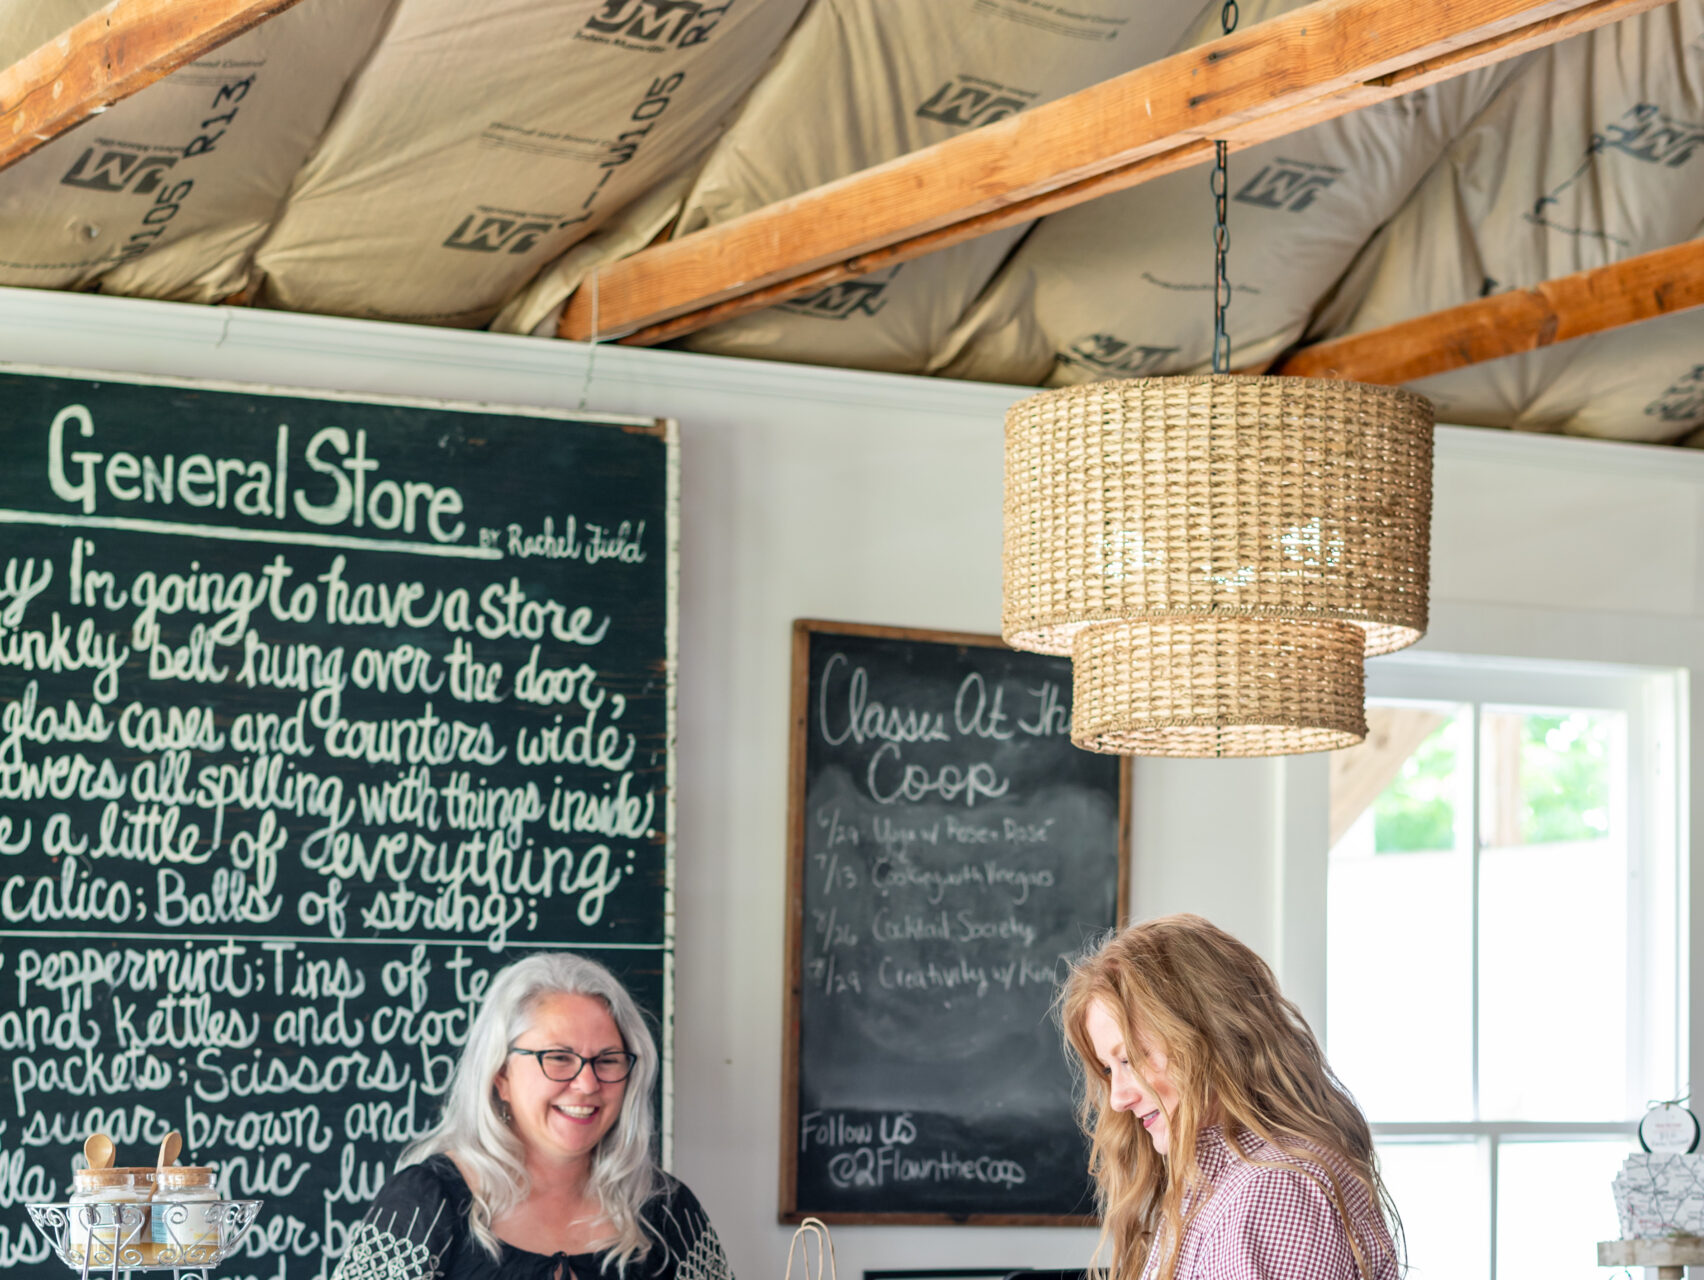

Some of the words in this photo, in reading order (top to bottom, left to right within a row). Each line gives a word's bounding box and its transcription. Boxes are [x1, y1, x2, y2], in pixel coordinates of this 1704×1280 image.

[182, 72, 257, 160] R13
[294, 427, 466, 543] Store
[506, 514, 582, 560] Rachel
[585, 519, 647, 565] Field
[70, 537, 128, 610] I'm
[132, 561, 271, 652] going
[262, 554, 318, 624] to
[318, 555, 444, 629] have
[443, 587, 474, 632] a
[475, 576, 611, 646] store
[149, 622, 230, 683] bell
[236, 628, 347, 729] hung
[352, 643, 446, 695] over
[443, 636, 512, 703] the
[515, 643, 626, 720] door,
[954, 671, 1016, 741] At
[0, 679, 115, 776] glass
[118, 700, 226, 754] cases
[230, 698, 315, 758] and
[324, 701, 508, 766] counters
[131, 749, 199, 806] all
[197, 753, 356, 869] spilling
[358, 765, 442, 832] with
[440, 770, 546, 850] things
[867, 742, 1010, 808] Coop
[42, 813, 89, 856] a
[89, 801, 214, 866] little
[229, 809, 289, 898] of
[317, 830, 636, 927] everything:
[2, 856, 147, 924] calico;
[154, 867, 284, 928] Balls
[298, 876, 348, 940] of
[360, 879, 538, 954] string;
[261, 942, 366, 1000] Tins
[381, 944, 432, 1014] of
[273, 997, 365, 1048] and
[194, 1047, 411, 1103] Scissors
[185, 1095, 334, 1154] brown
[344, 1080, 430, 1144] and
[801, 1110, 873, 1153] Follow
